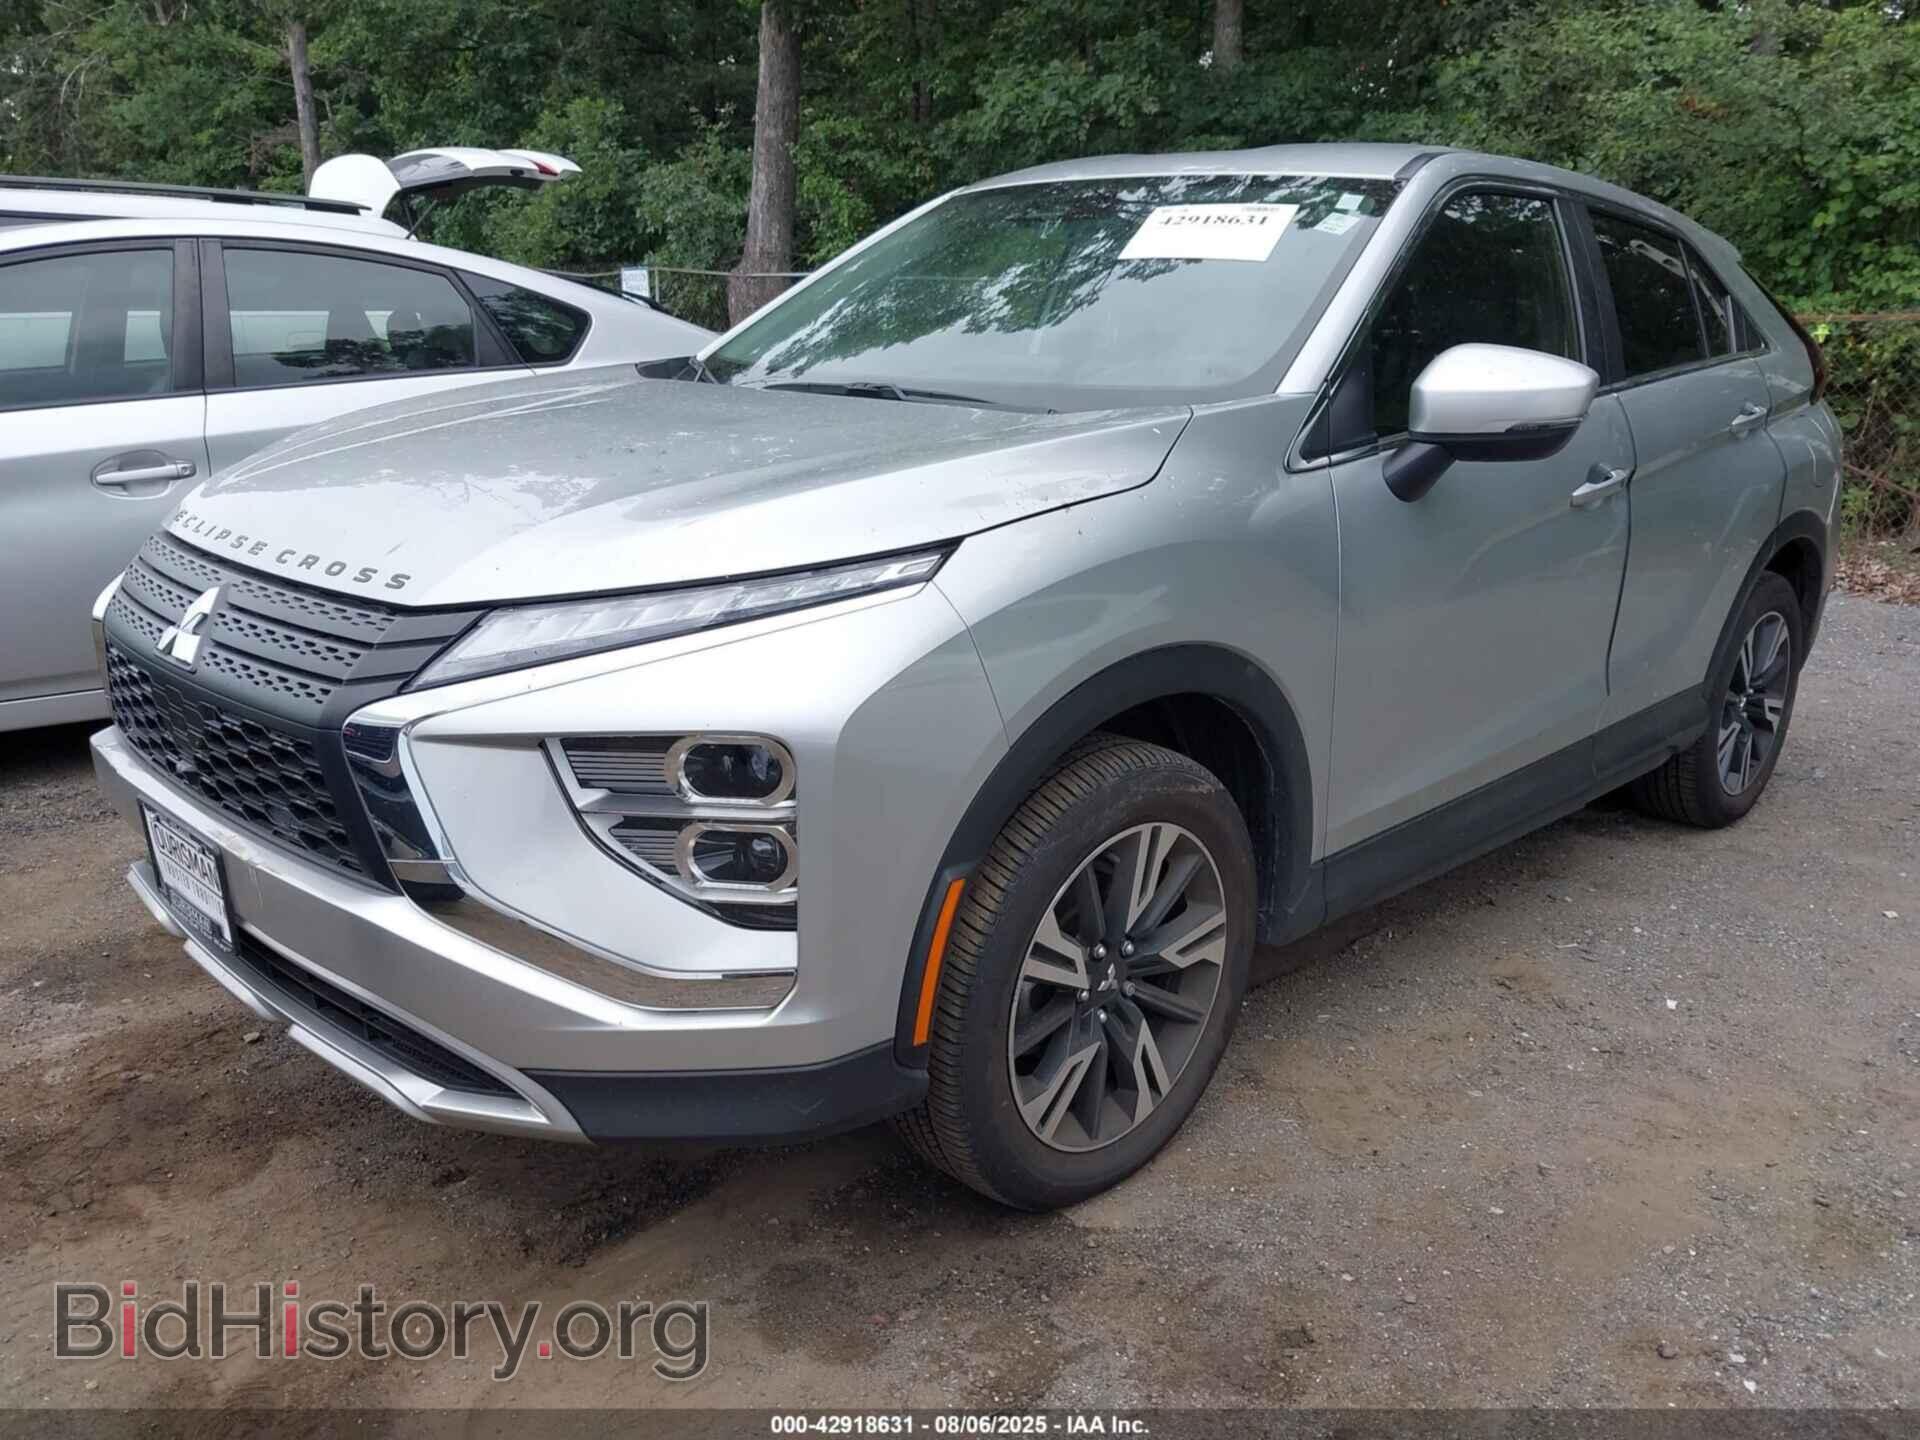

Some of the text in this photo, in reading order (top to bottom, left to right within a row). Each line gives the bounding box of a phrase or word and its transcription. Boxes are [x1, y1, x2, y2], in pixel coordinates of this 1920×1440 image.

[1159, 215, 1269, 226] 42918631
[175, 509, 412, 590] ECLIPSE CROSS
